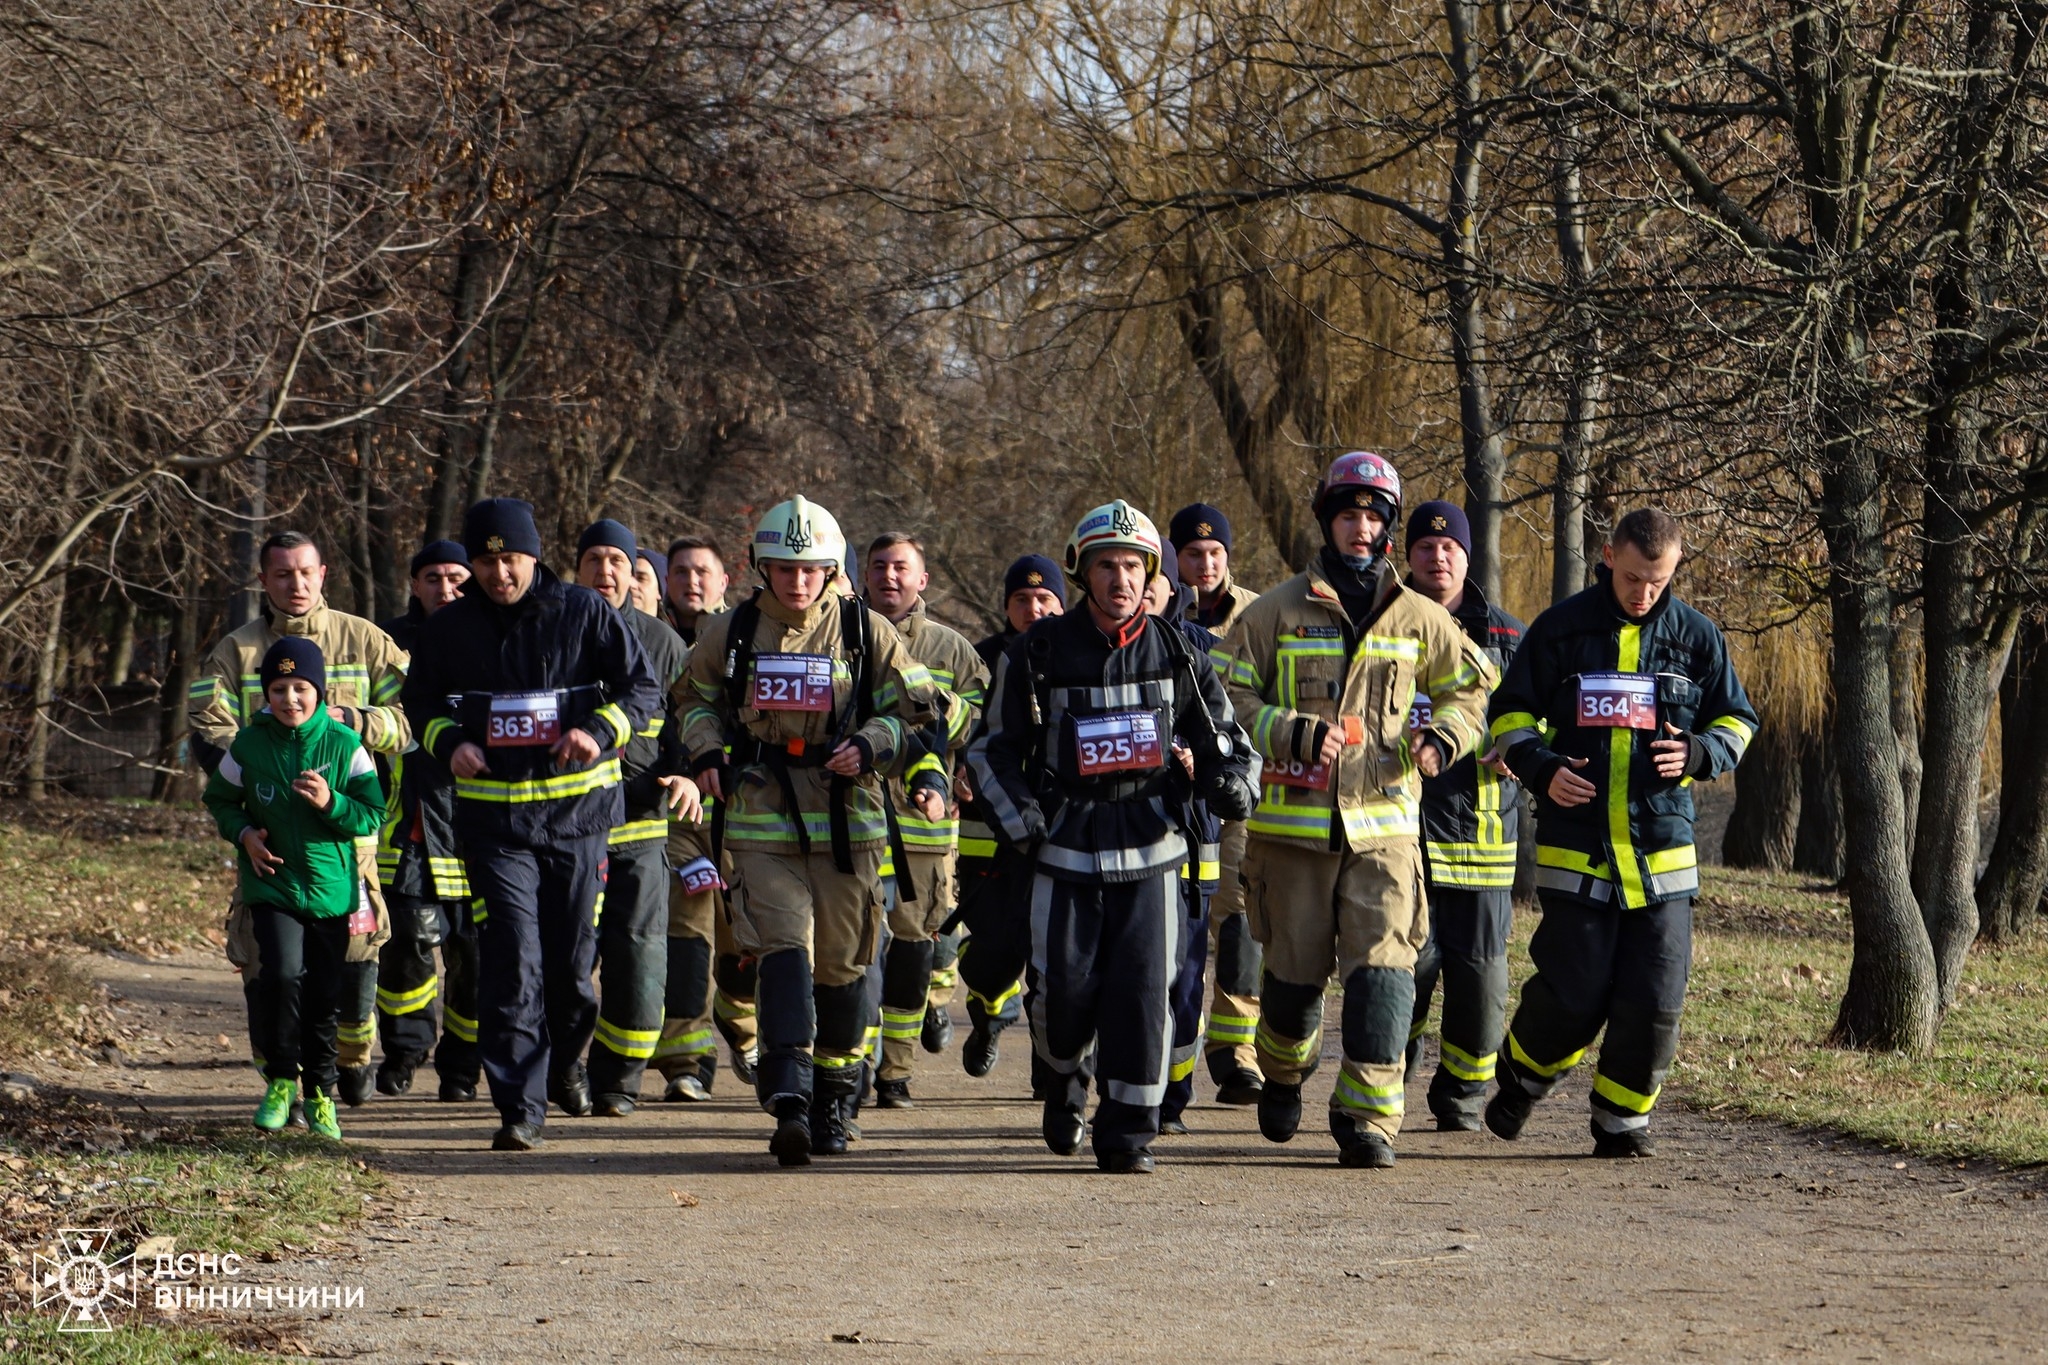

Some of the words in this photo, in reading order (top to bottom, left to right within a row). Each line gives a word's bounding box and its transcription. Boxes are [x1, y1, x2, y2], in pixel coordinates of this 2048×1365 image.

[758, 677, 802, 701] 321
[1583, 695, 1630, 718] 364
[491, 715, 535, 739] 363
[1081, 738, 1132, 766] 325
